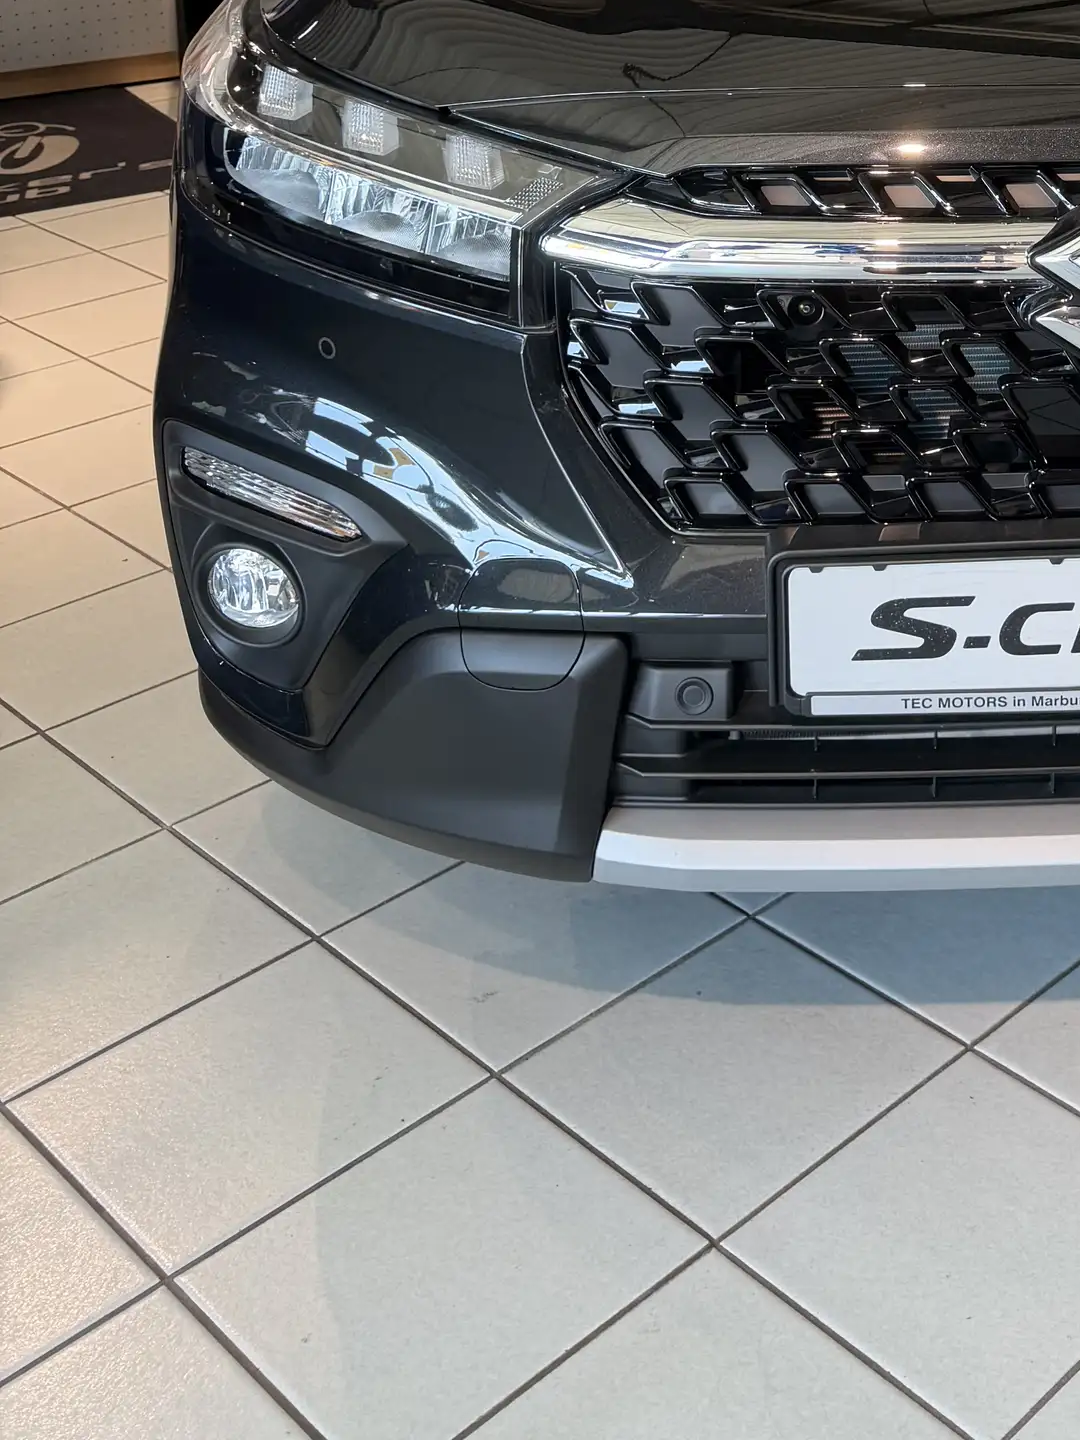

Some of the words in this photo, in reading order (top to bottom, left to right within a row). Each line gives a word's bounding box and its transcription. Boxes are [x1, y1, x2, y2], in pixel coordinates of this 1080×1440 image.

[901, 697, 933, 710] TEC
[937, 696, 1008, 709] MOTORS
[1012, 695, 1026, 708] in
